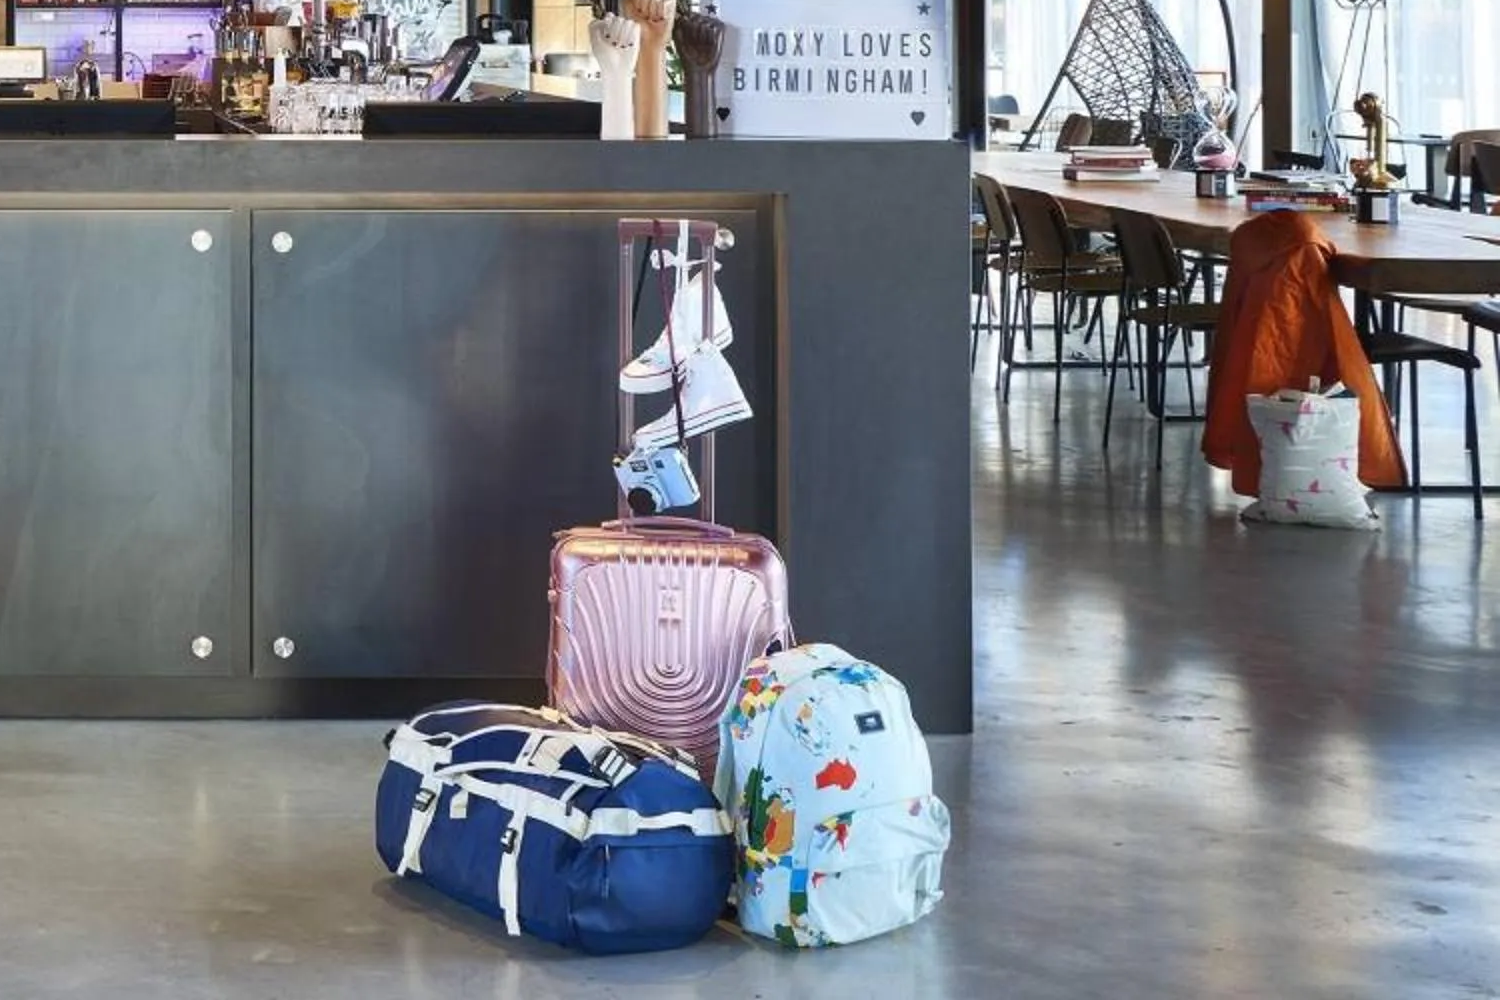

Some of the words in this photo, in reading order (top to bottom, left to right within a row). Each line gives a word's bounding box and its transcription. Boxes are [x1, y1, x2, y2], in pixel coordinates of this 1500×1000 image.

[757, 33, 824, 56] MOXY
[844, 33, 932, 57] LOVES
[734, 69, 928, 94] BIRMINGHAM!
